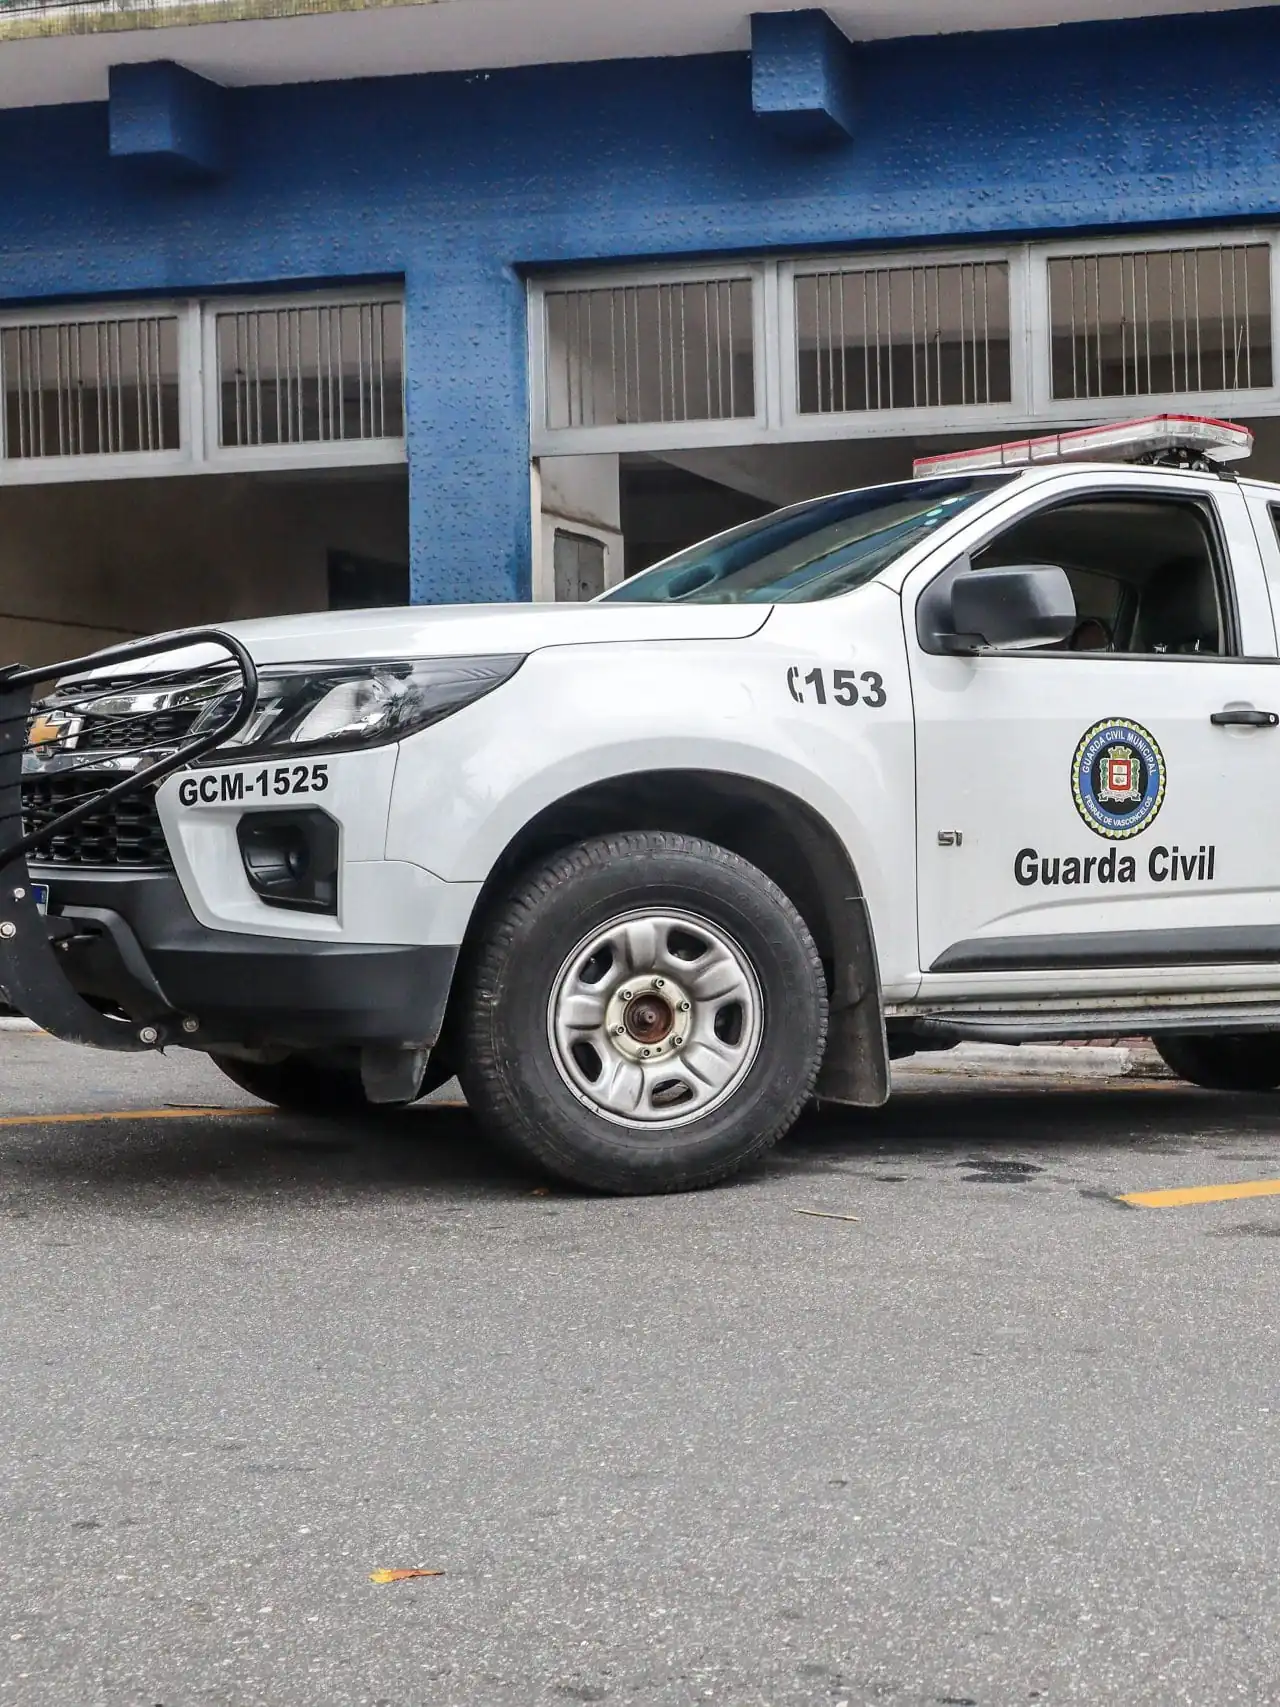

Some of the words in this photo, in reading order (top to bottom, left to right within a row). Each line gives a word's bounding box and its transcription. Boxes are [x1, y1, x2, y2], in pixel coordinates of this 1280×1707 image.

[805, 668, 887, 708] 153
[1082, 737, 1106, 773] GUARDA
[1105, 730, 1125, 741] CIVIL
[1127, 732, 1157, 776] MUNICIPAL
[179, 764, 329, 807] GCM-1525
[1085, 794, 1104, 821] FERRAZ
[1103, 817, 1112, 826] DE
[1113, 796, 1153, 826] VASCONCELOS
[1014, 847, 1136, 886] Guarda
[1148, 845, 1216, 882] Civil
